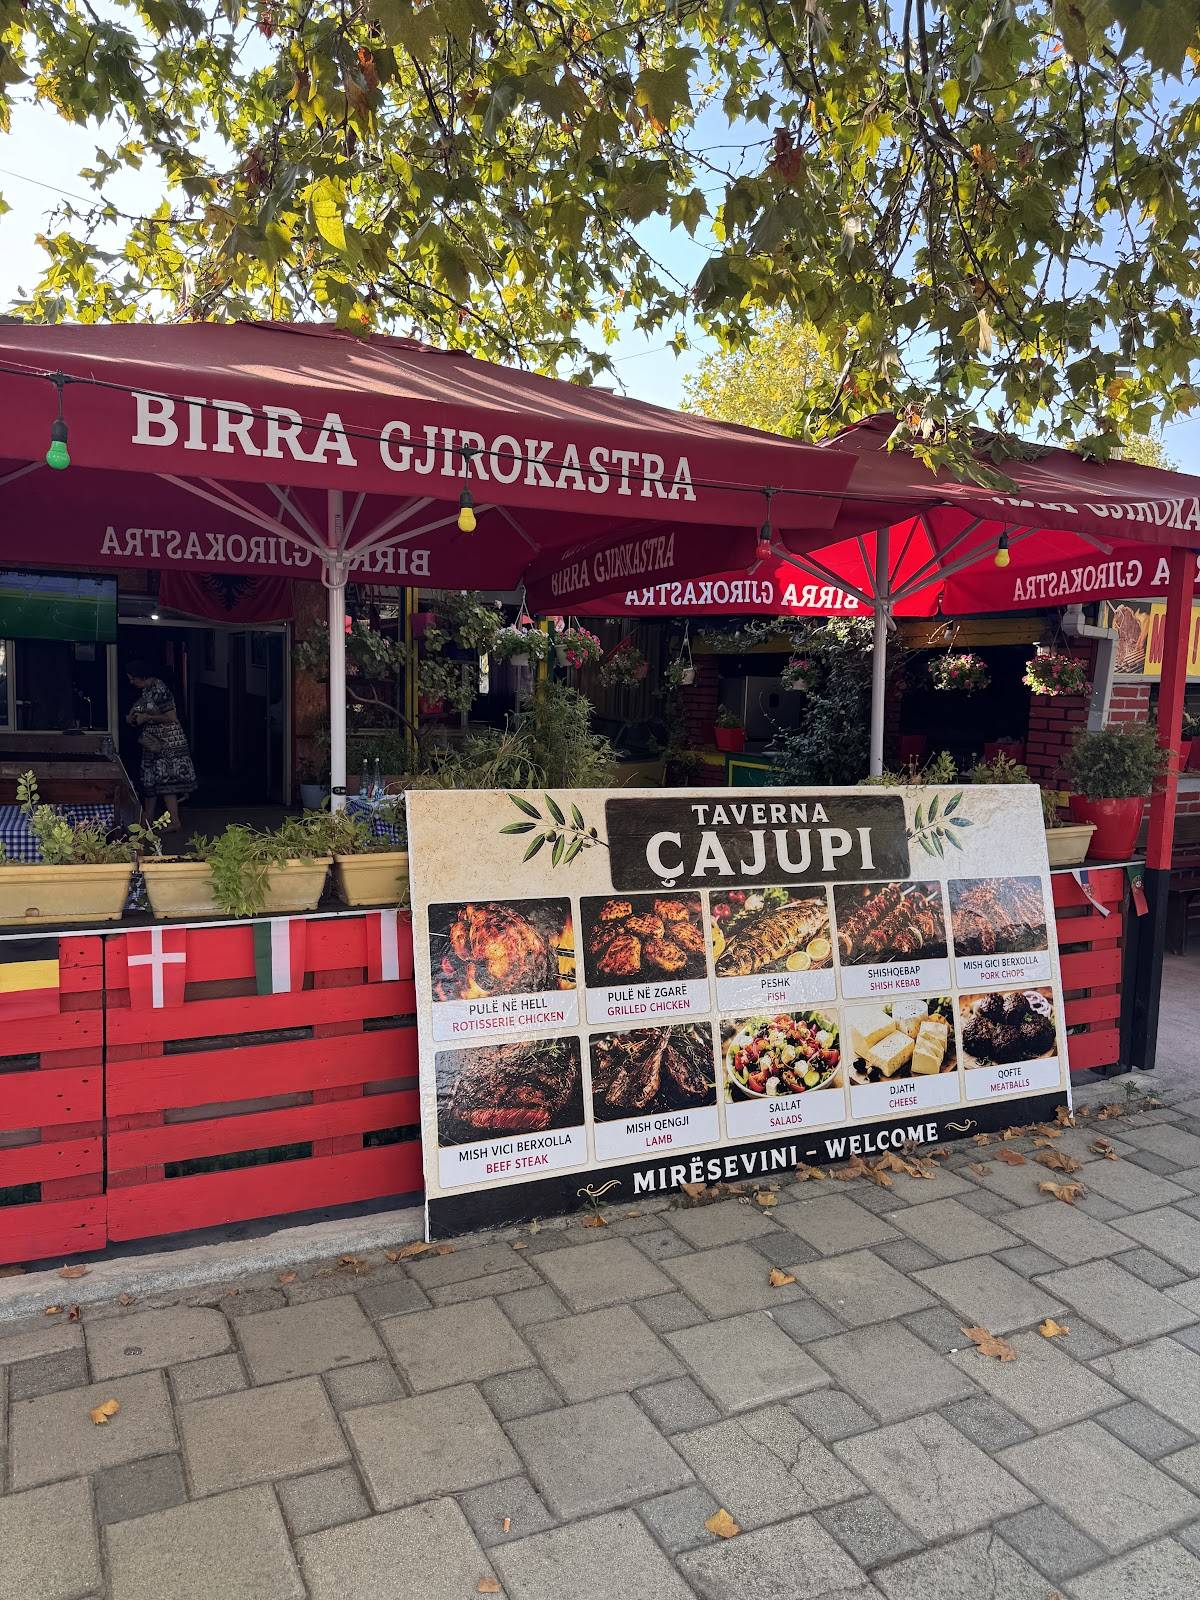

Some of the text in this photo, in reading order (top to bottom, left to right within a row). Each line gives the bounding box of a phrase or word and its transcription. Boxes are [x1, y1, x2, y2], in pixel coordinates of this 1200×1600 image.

[131, 391, 697, 502] BIRRA GJIROKASTRA
[551, 559, 590, 597] BIRRA
[593, 532, 675, 583] GJIROKASTRA
[691, 802, 830, 826] TAVERNA
[645, 827, 876, 888] ÇAJUPI
[963, 955, 1039, 970] MISH GICI BERXOLLA
[868, 965, 921, 979] SHISHQEBAP
[981, 969, 1025, 980] PORK CHOPS
[761, 977, 790, 989] PESHK
[870, 978, 921, 991] SHISH KEBAB
[608, 985, 688, 1003] PULË NË ZGARË
[767, 992, 786, 1002] FISH
[469, 998, 548, 1016] PULË NË HELL
[607, 999, 690, 1017] GRILLED CHICKEN
[452, 1011, 564, 1033] ROTISSERIE CHICKEN
[998, 1067, 1022, 1079] QOFTE
[890, 1083, 916, 1095] DJATH
[990, 1078, 1030, 1093] MEATBALLS
[769, 1099, 801, 1113] SALLAT
[889, 1096, 918, 1109] CHEESE
[626, 1116, 690, 1135] MISH QENGJI
[769, 1113, 803, 1127] SALADS
[459, 1134, 573, 1162] MISH VICI BERXOLLA
[645, 1134, 673, 1147] LAMB
[486, 1154, 549, 1174] BEEF STEAK
[632, 1145, 798, 1194] MIRËSEVINI
[824, 1122, 939, 1160] WELCOME
